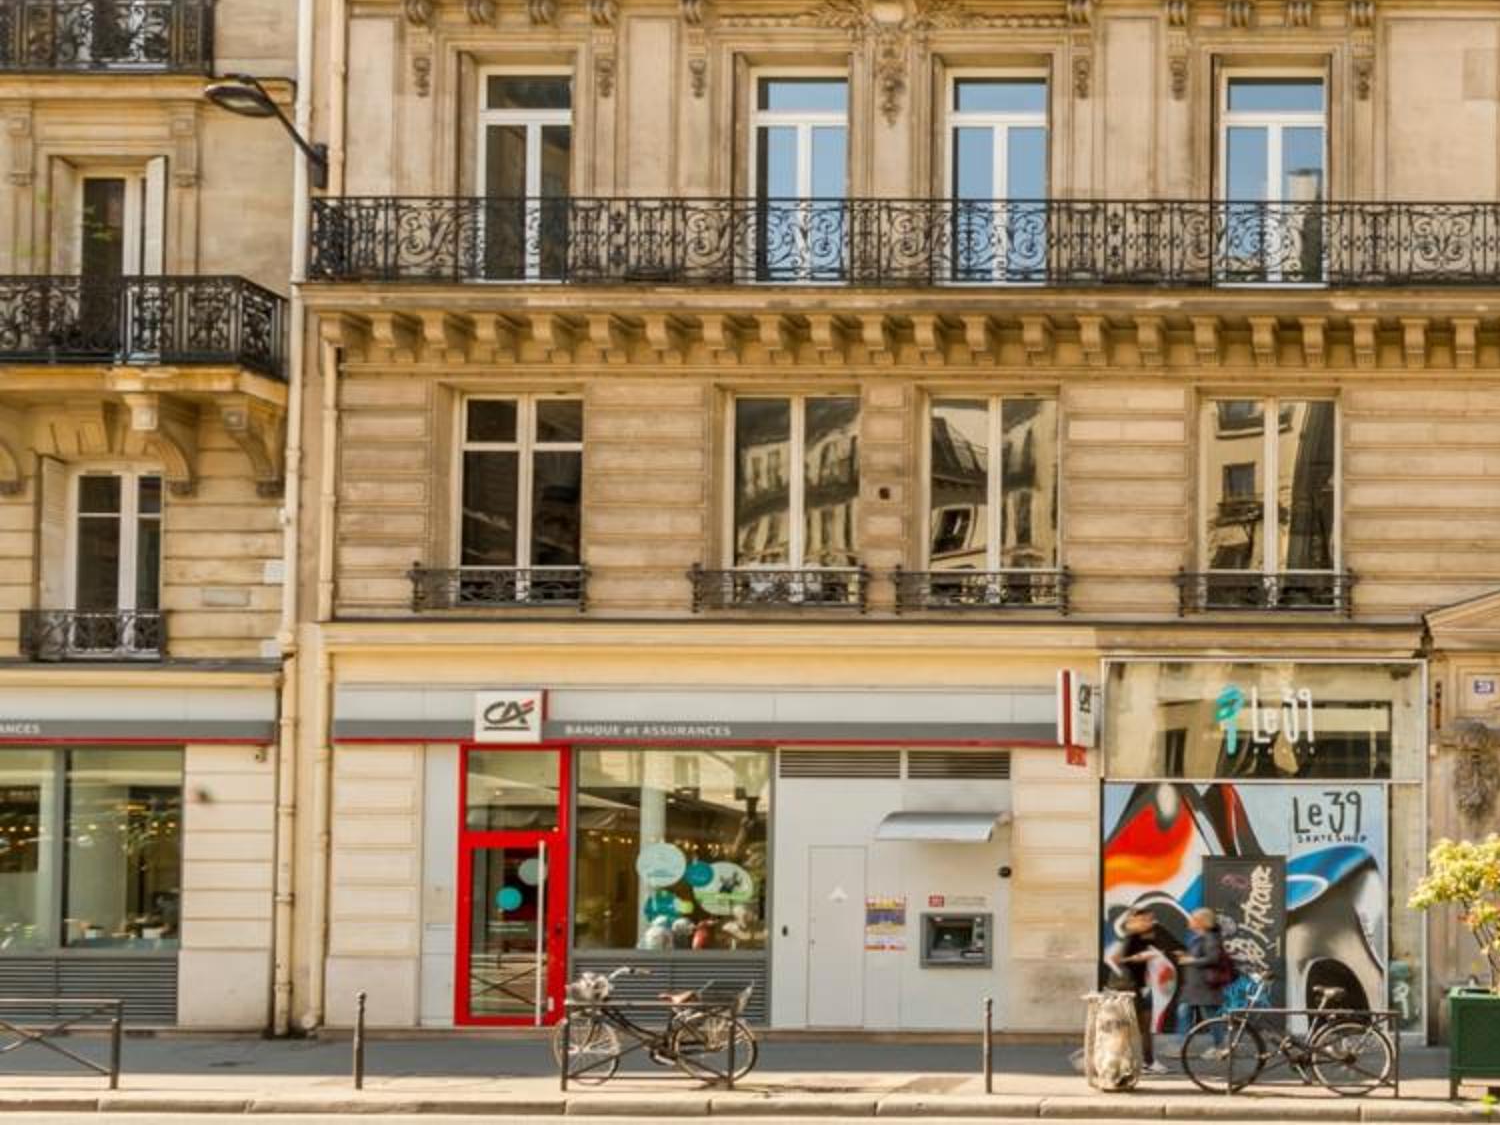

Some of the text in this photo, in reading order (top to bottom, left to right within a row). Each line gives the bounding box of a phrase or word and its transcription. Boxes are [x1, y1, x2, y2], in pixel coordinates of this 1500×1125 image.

[564, 725, 732, 736] BANQUE et ASSURANCES
[1293, 790, 1362, 843] Le 39
